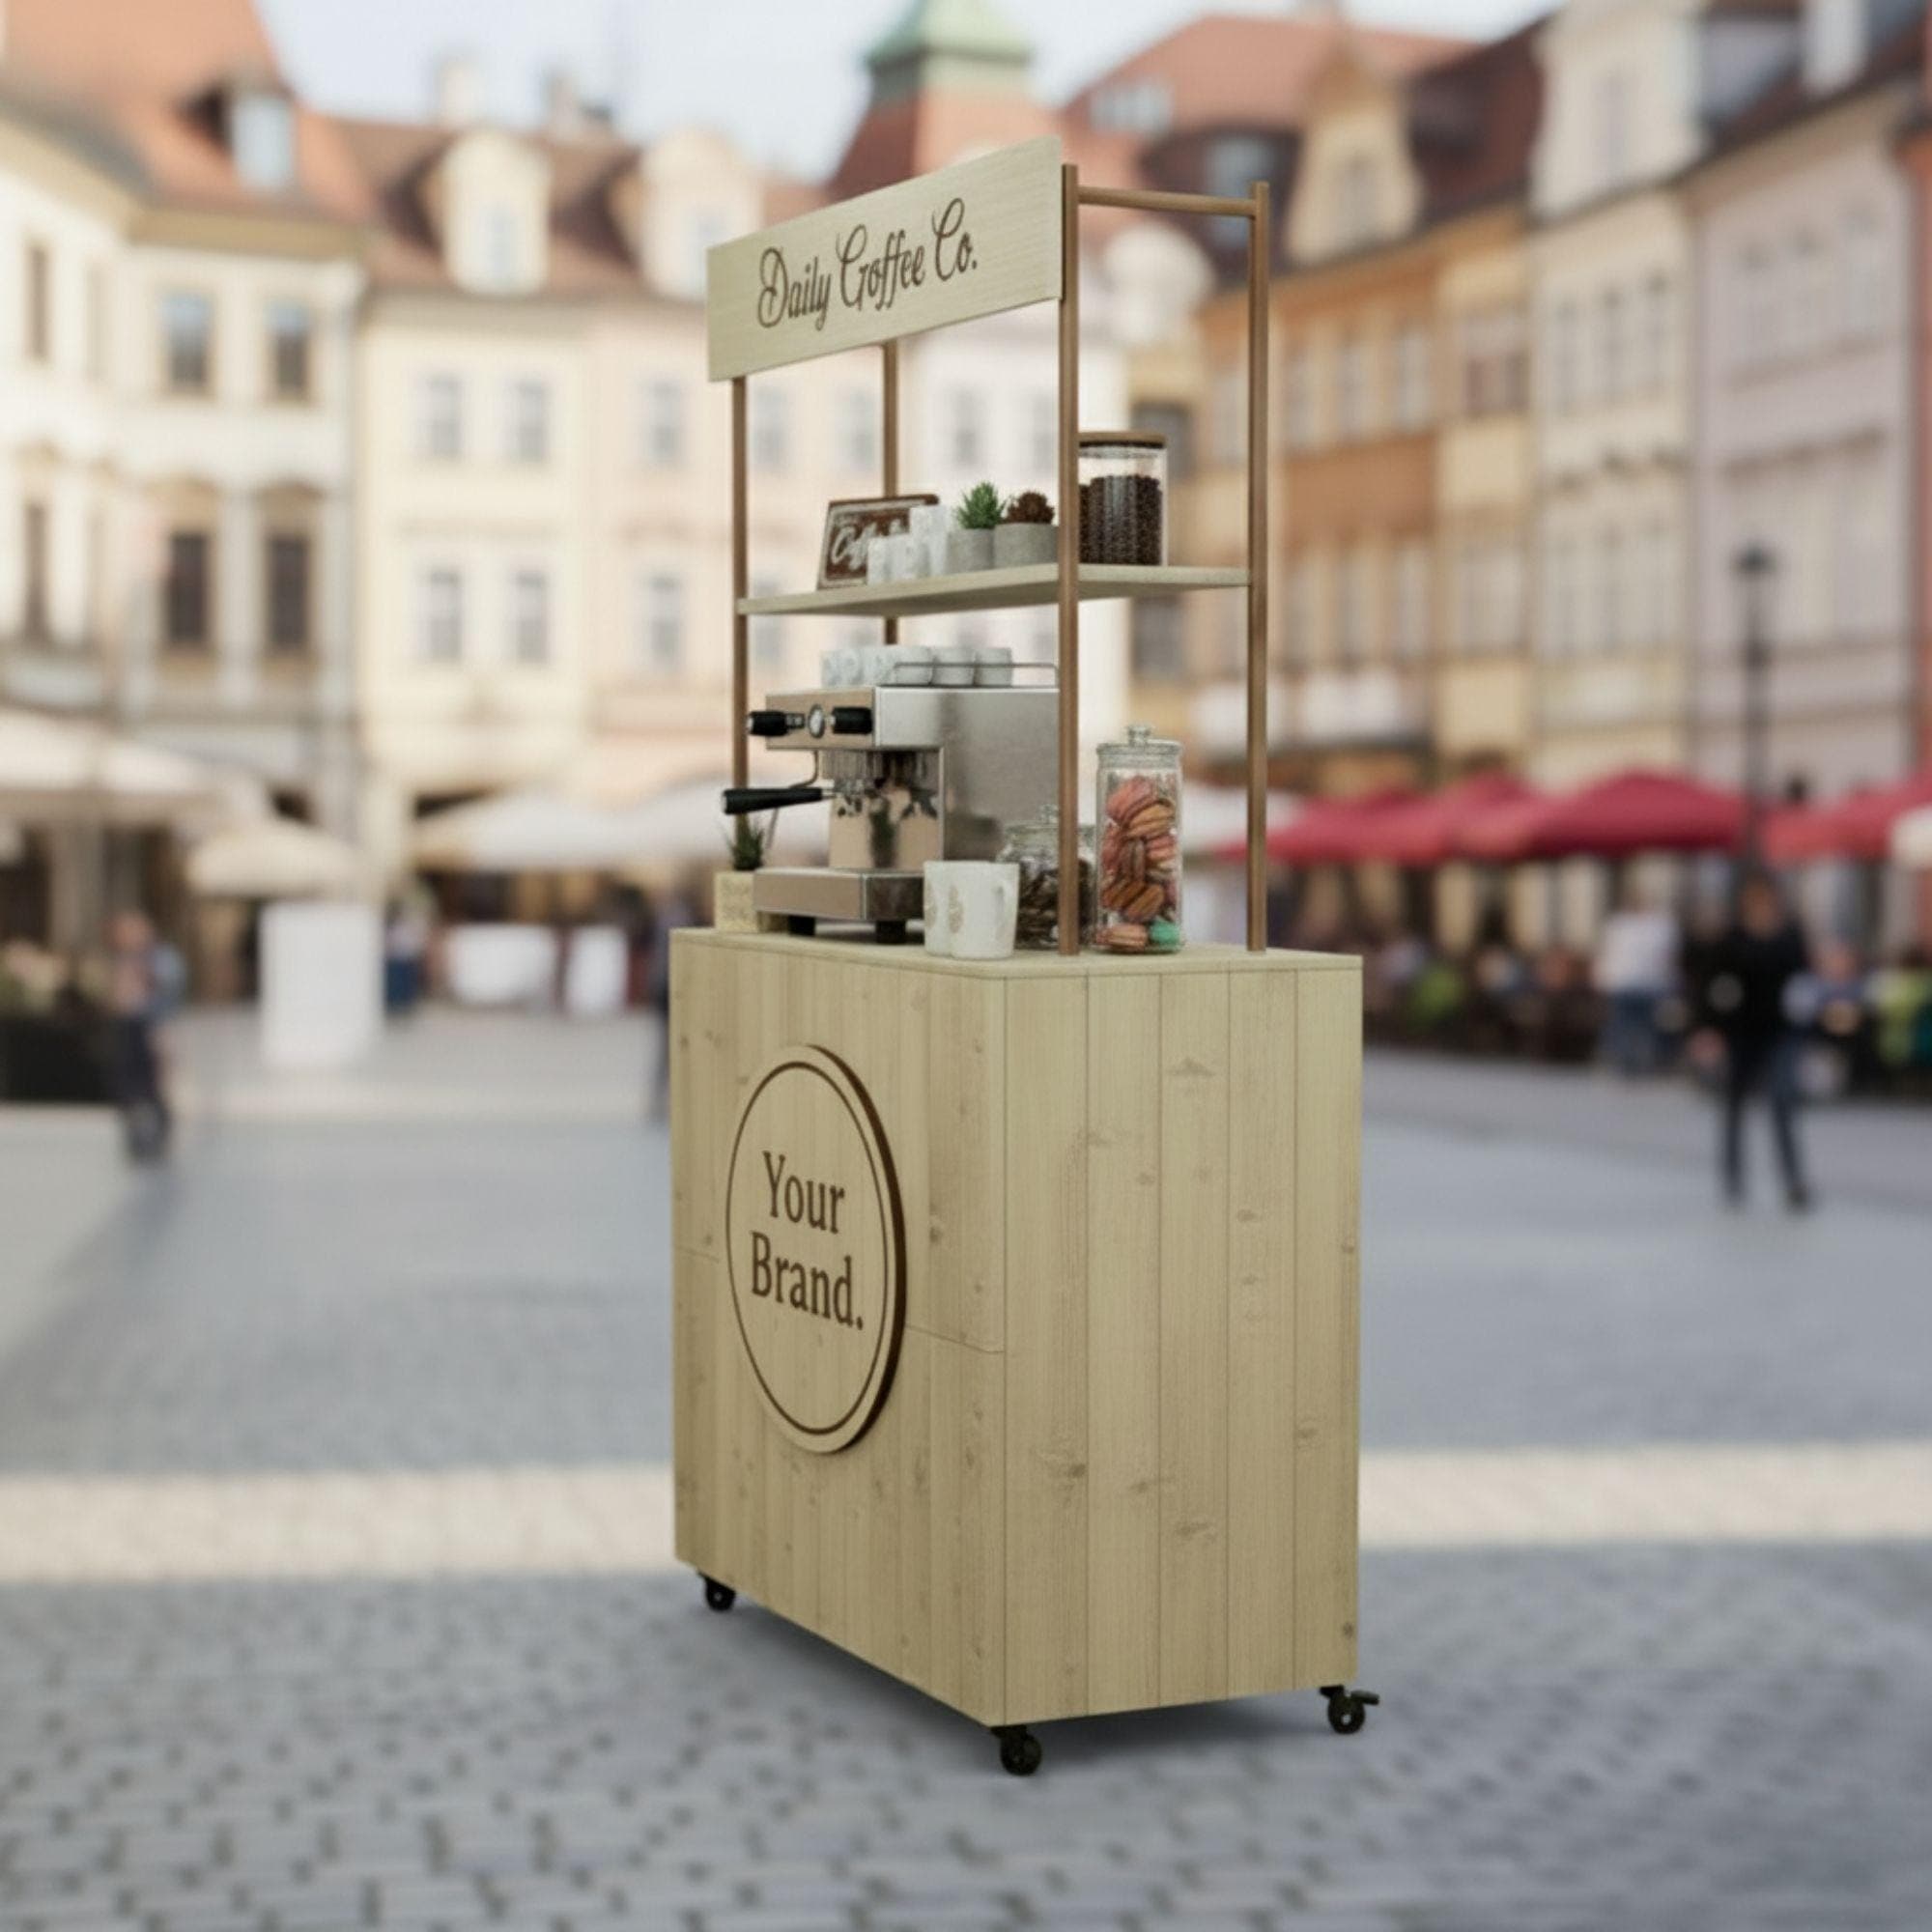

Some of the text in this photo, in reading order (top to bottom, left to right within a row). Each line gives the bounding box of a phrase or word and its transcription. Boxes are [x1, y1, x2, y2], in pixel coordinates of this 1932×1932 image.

[757, 245, 832, 331] Daily
[930, 197, 979, 283] Co.
[762, 1150, 846, 1236] Your
[751, 1230, 865, 1331] Brand.
